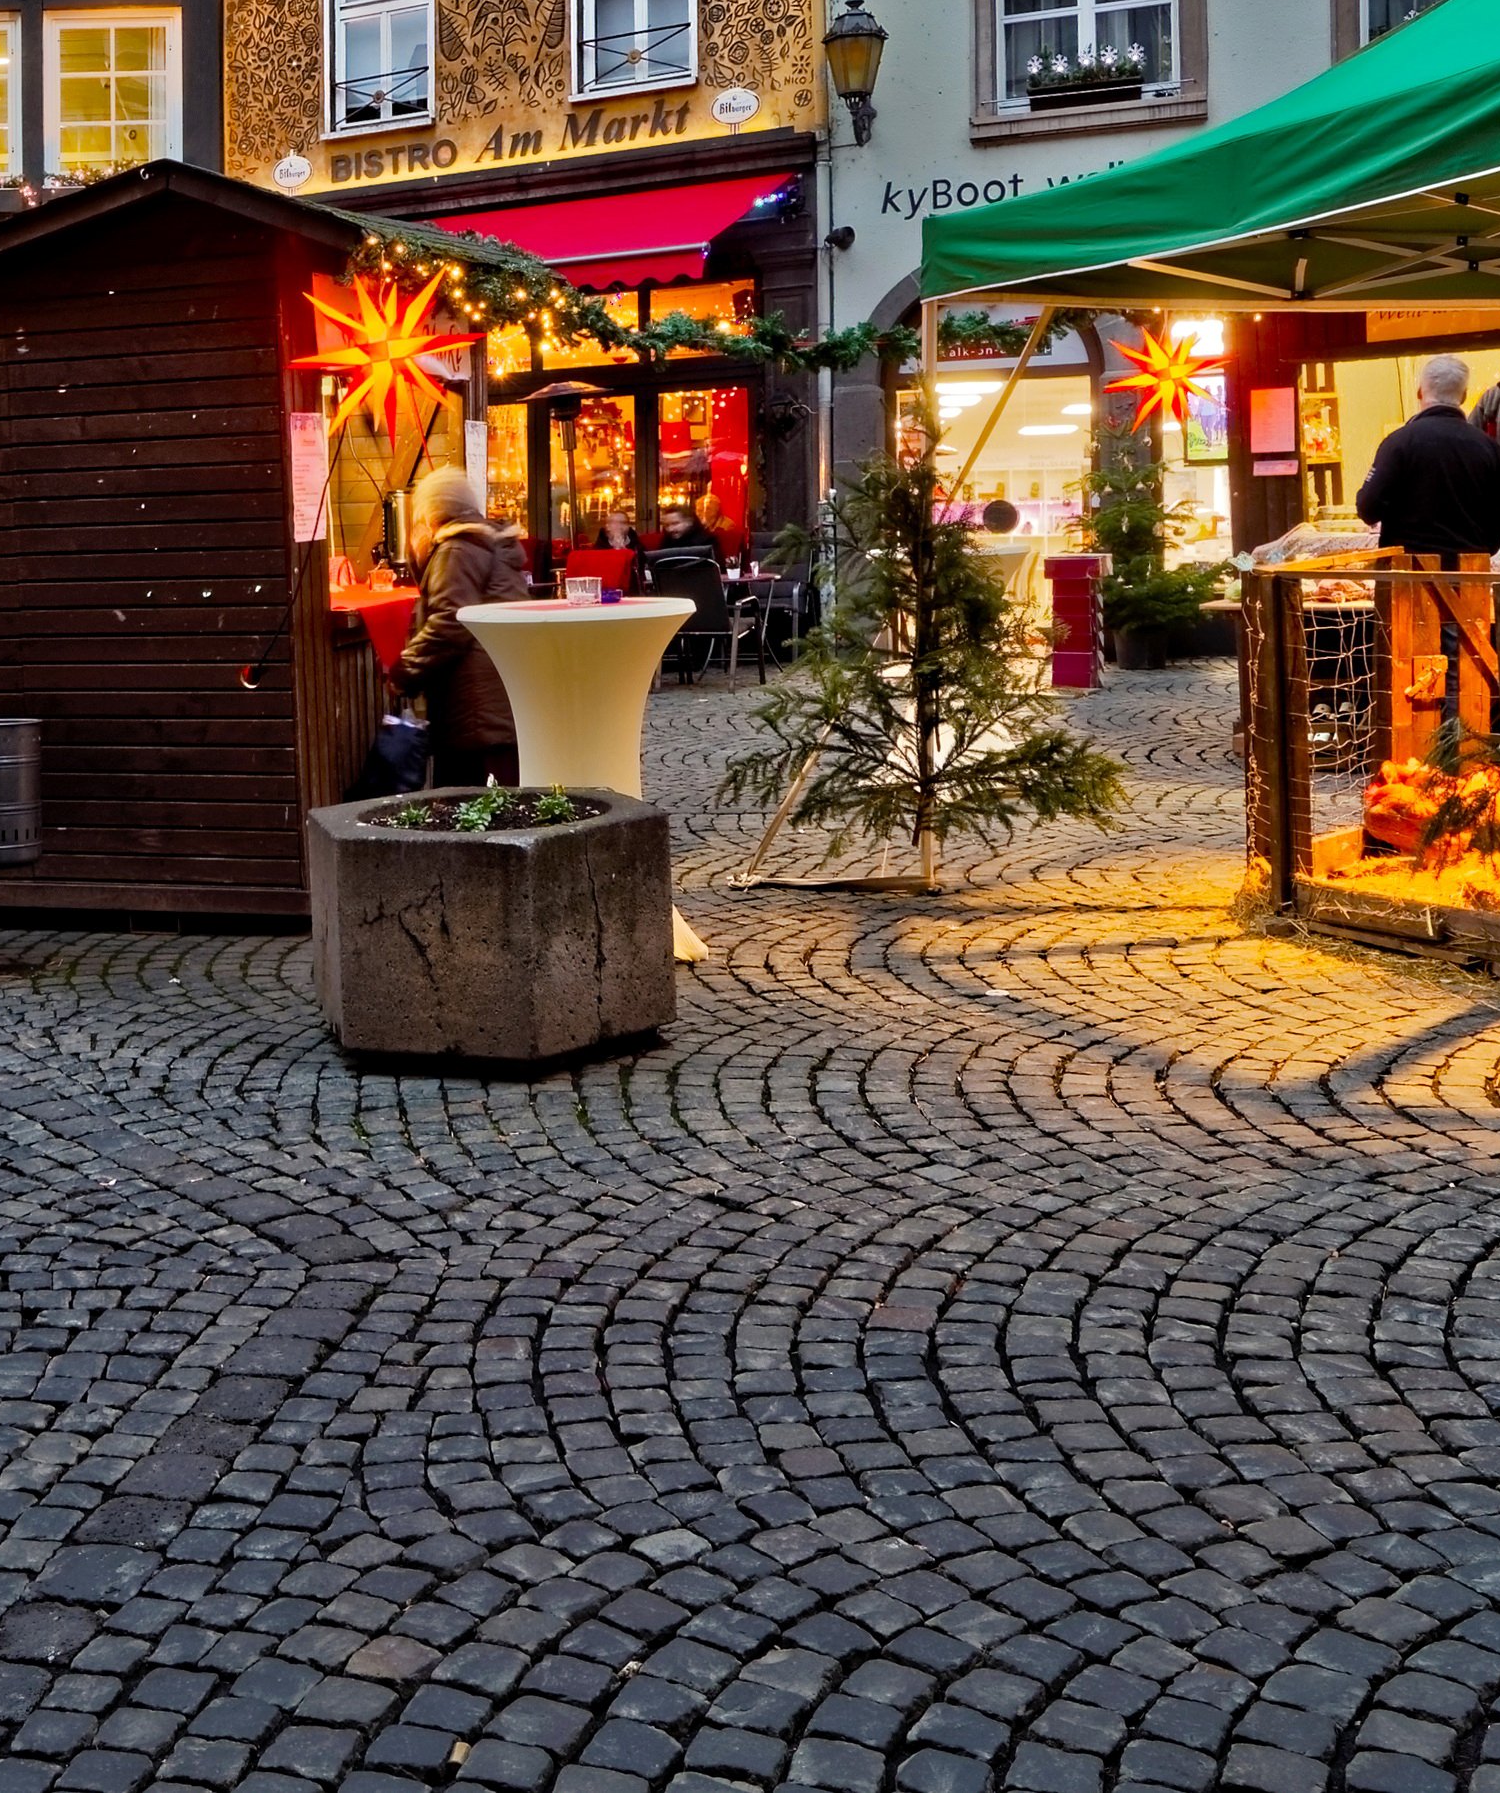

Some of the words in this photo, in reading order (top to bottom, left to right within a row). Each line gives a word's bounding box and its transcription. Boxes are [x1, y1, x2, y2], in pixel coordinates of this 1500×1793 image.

[331, 139, 458, 184] BISTRO
[475, 124, 543, 163] Am
[557, 98, 690, 152] Markt
[881, 173, 1024, 220] kyBoot
